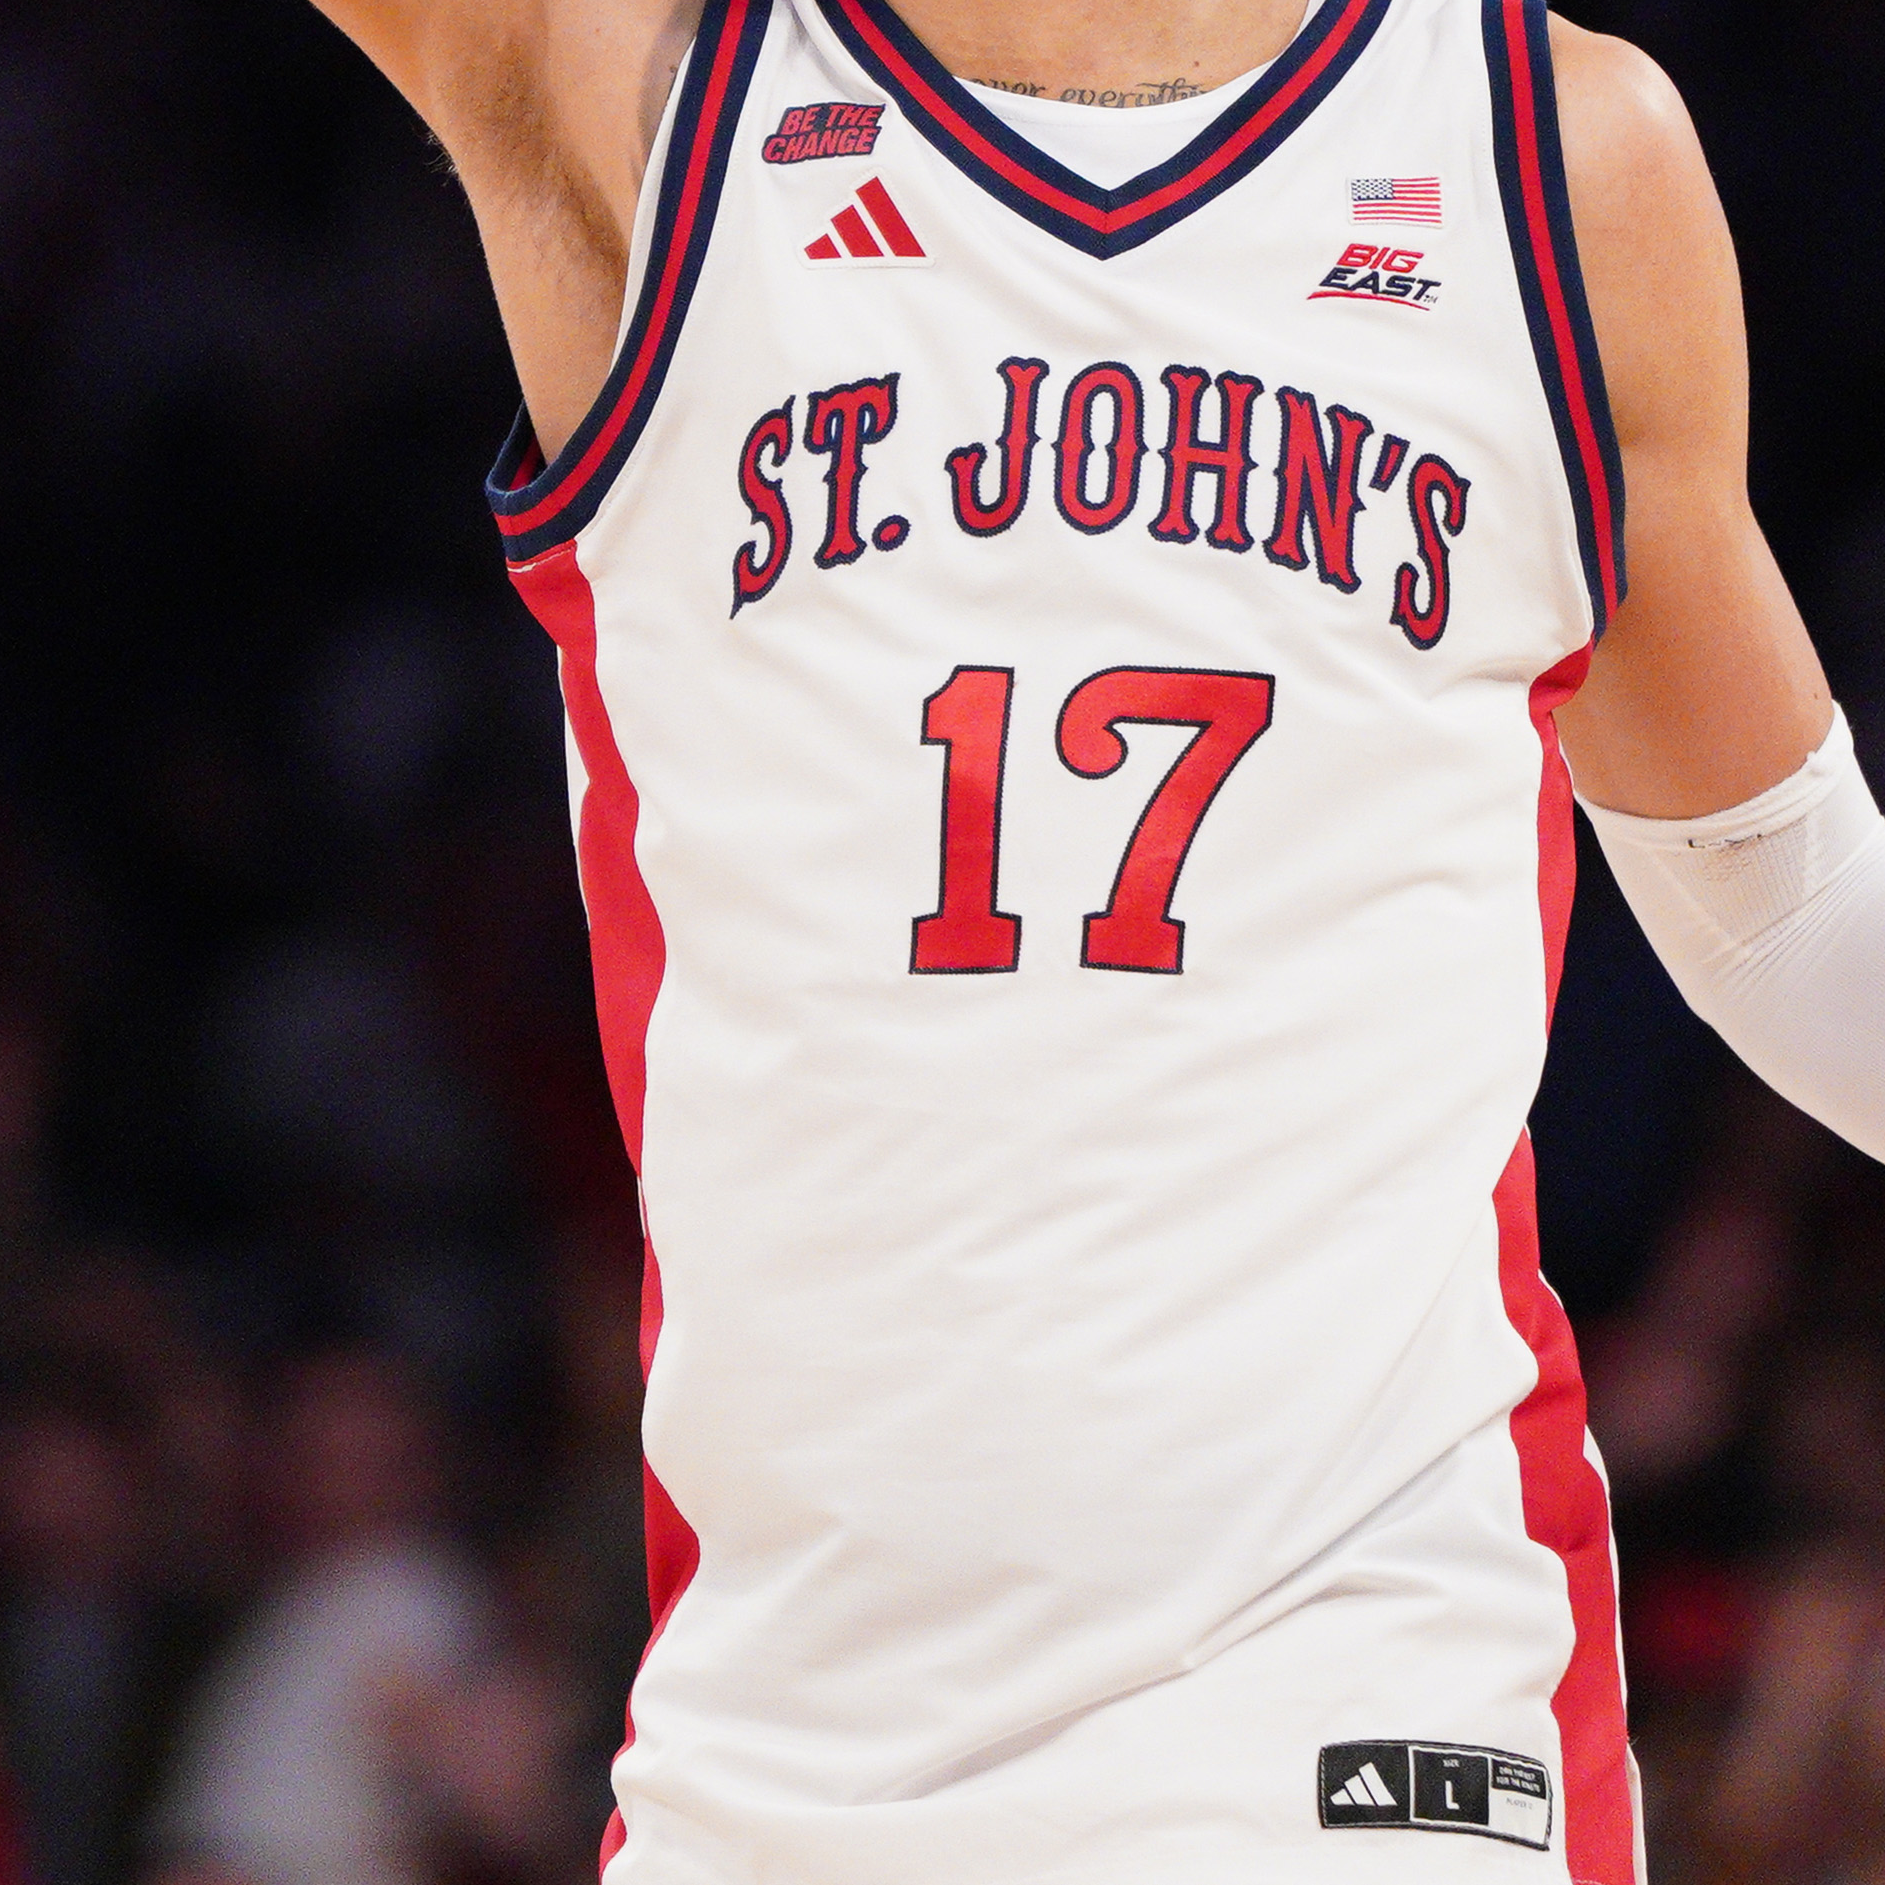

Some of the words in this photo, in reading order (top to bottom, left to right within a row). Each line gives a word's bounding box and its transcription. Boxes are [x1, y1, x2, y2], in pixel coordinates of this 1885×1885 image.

[780, 105, 820, 135] BE
[825, 103, 883, 128] THE
[763, 127, 879, 162] CHANGE
[1336, 243, 1425, 274] BIG
[1319, 267, 1442, 301] EAST
[730, 372, 911, 620] ST.
[944, 356, 1471, 650] JOHN'S
[909, 665, 1276, 975] 17
[1445, 1780, 1461, 1810] L
